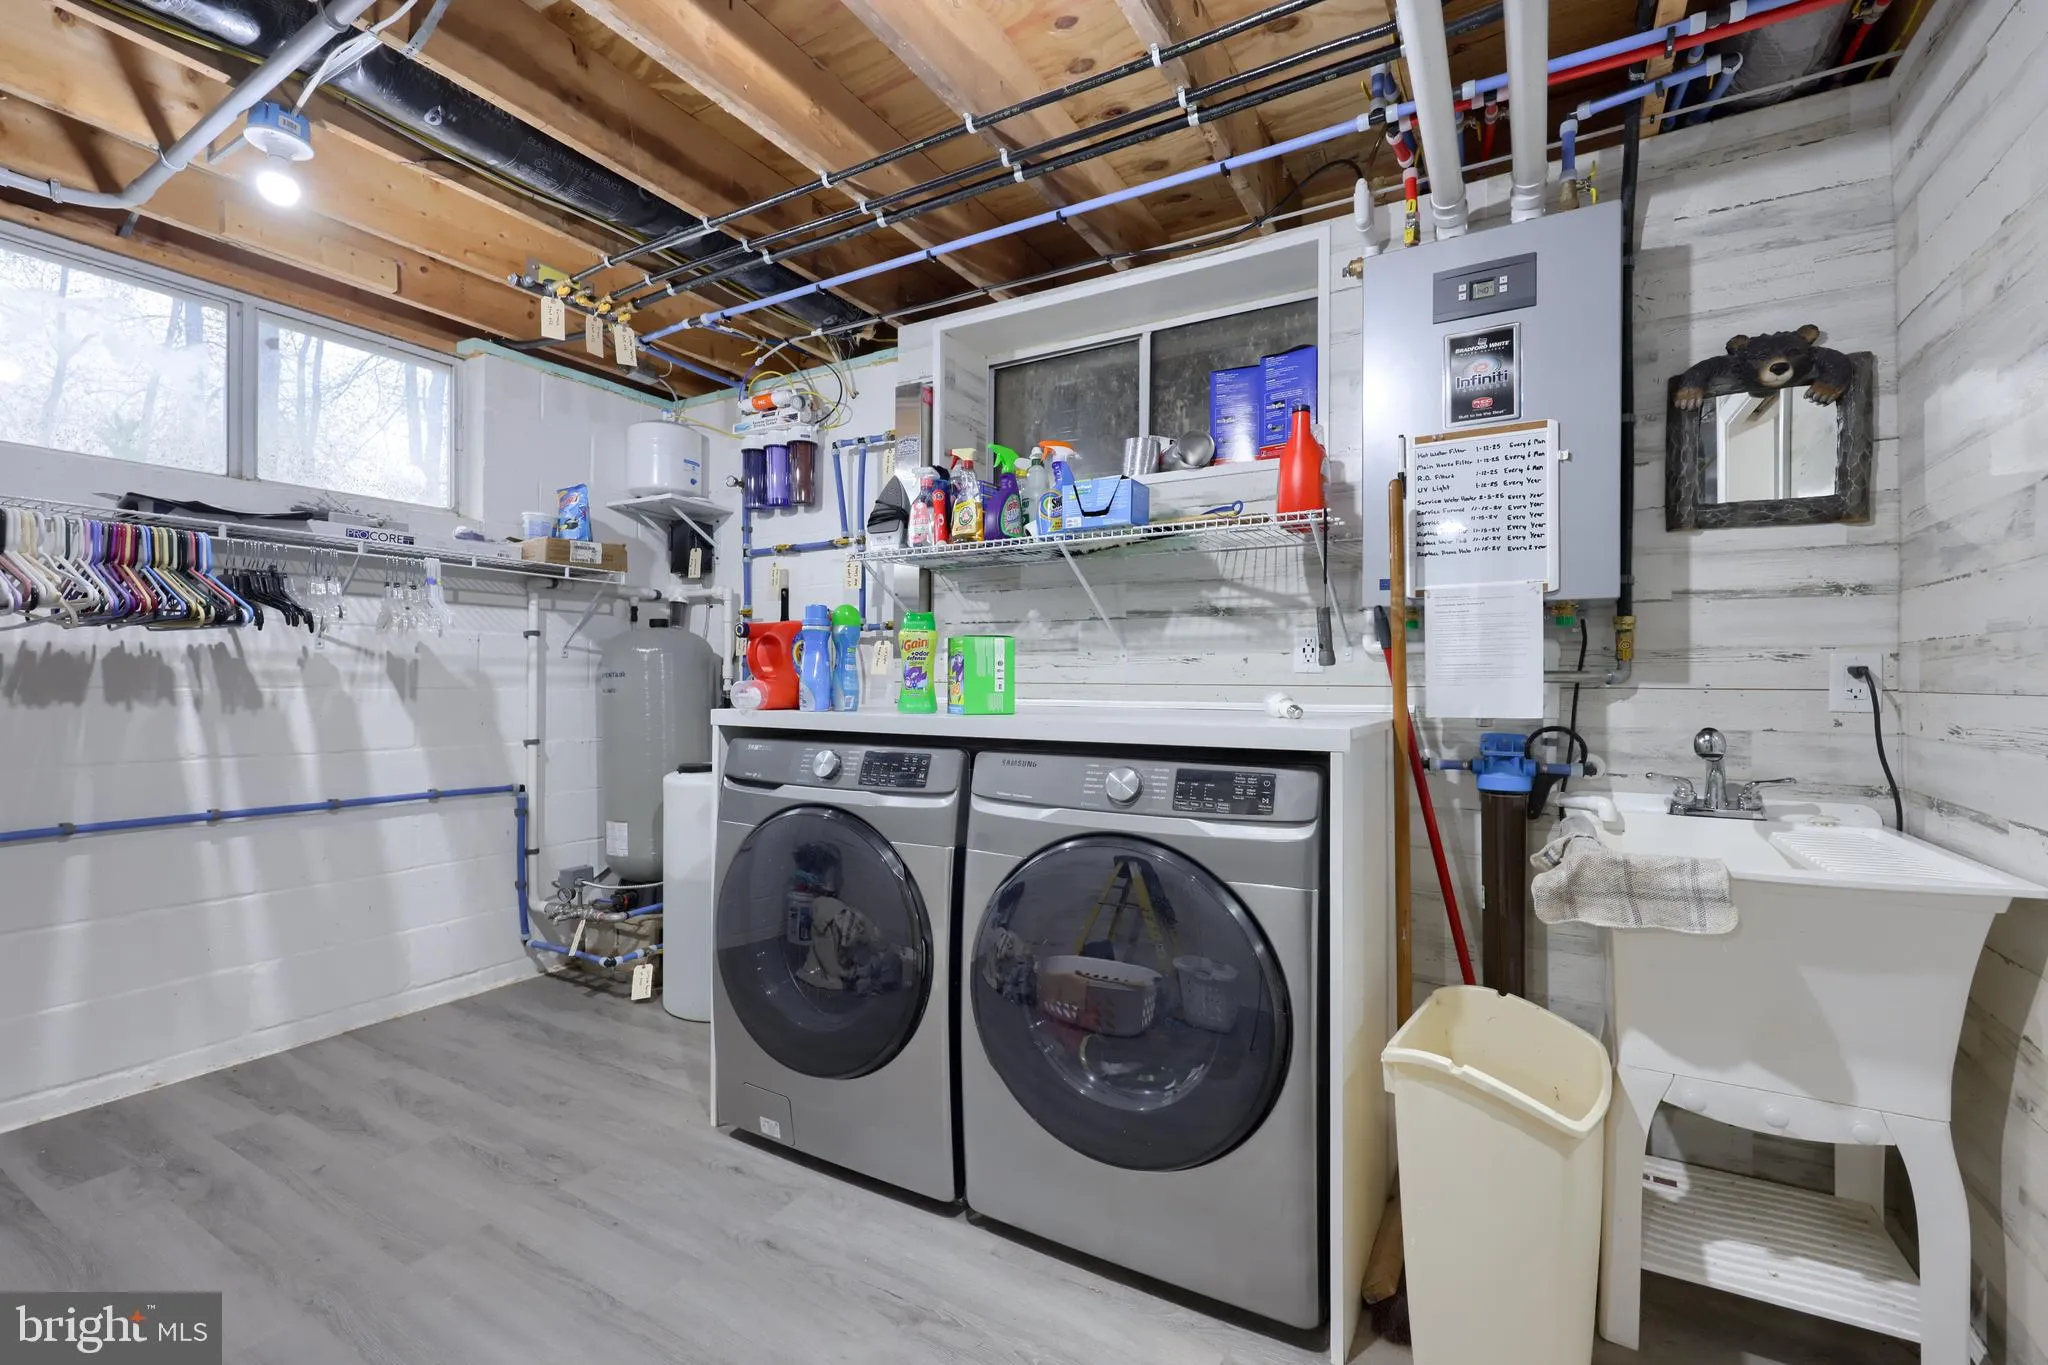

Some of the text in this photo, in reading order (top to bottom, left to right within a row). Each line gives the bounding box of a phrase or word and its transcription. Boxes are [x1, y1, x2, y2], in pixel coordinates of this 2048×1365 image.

[1455, 345, 1488, 354] BRADFORD
[1489, 340, 1510, 348] WHITE
[1456, 370, 1508, 388] Infiniti
[1476, 443, 1501, 452] 1-12-25
[1455, 459, 1473, 467] Filter
[1504, 453, 1526, 462] Every
[1432, 485, 1450, 493] Light
[1503, 480, 1524, 488] Every
[1526, 477, 1542, 485] Year
[1417, 520, 1440, 528] Service
[1507, 524, 1527, 532] Every
[1530, 521, 1546, 529] Year
[347, 528, 403, 544] PROCORE
[1507, 534, 1526, 542] Every
[1530, 531, 1545, 539] Year
[903, 639, 928, 651] Gain
